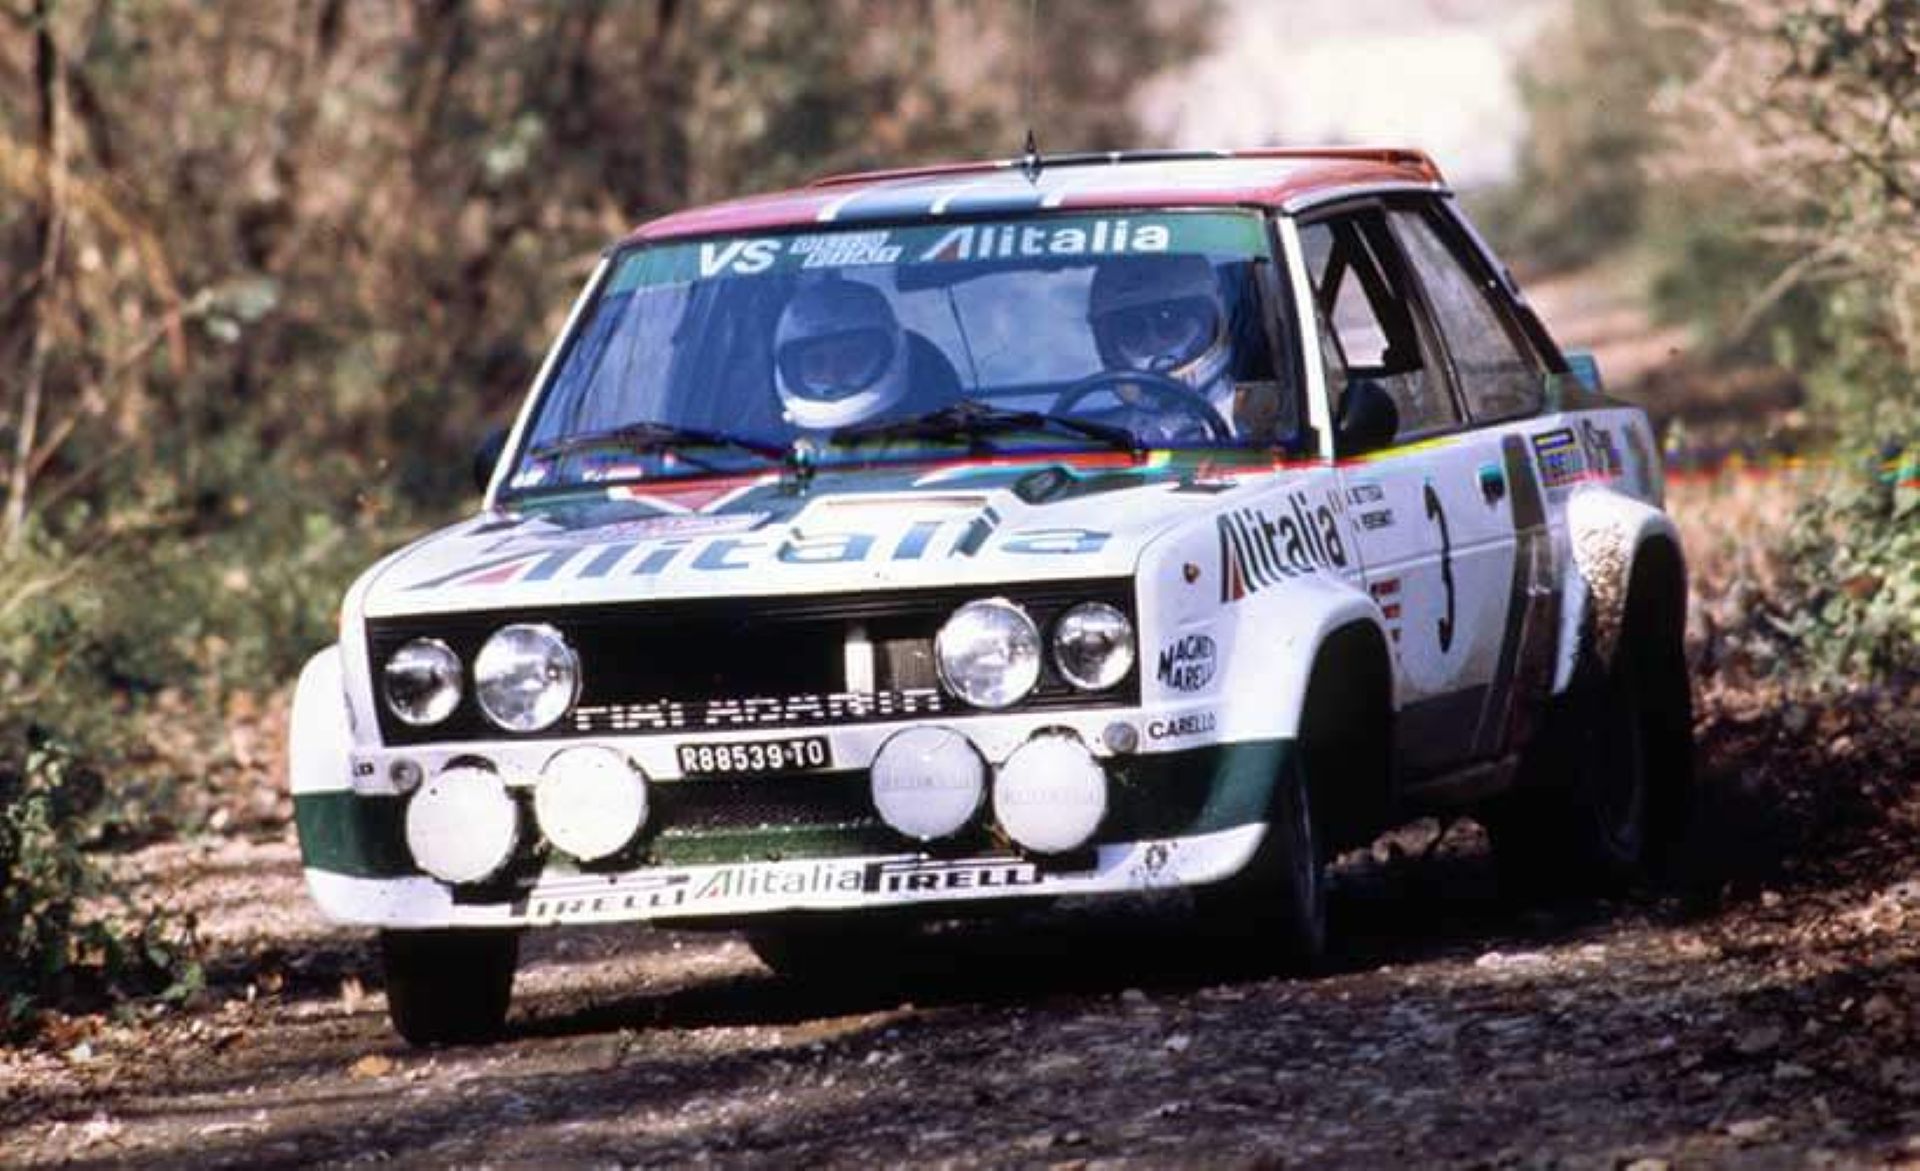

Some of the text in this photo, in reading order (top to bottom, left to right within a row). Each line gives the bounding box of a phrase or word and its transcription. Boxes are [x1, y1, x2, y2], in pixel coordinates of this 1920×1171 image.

[698, 239, 781, 276] VS
[921, 219, 1170, 263] Alitalia
[405, 505, 1112, 590] Alitalia
[1217, 490, 1346, 604] Alitalia
[1148, 711, 1217, 740] CARELLO
[695, 864, 862, 900] Alitalia
